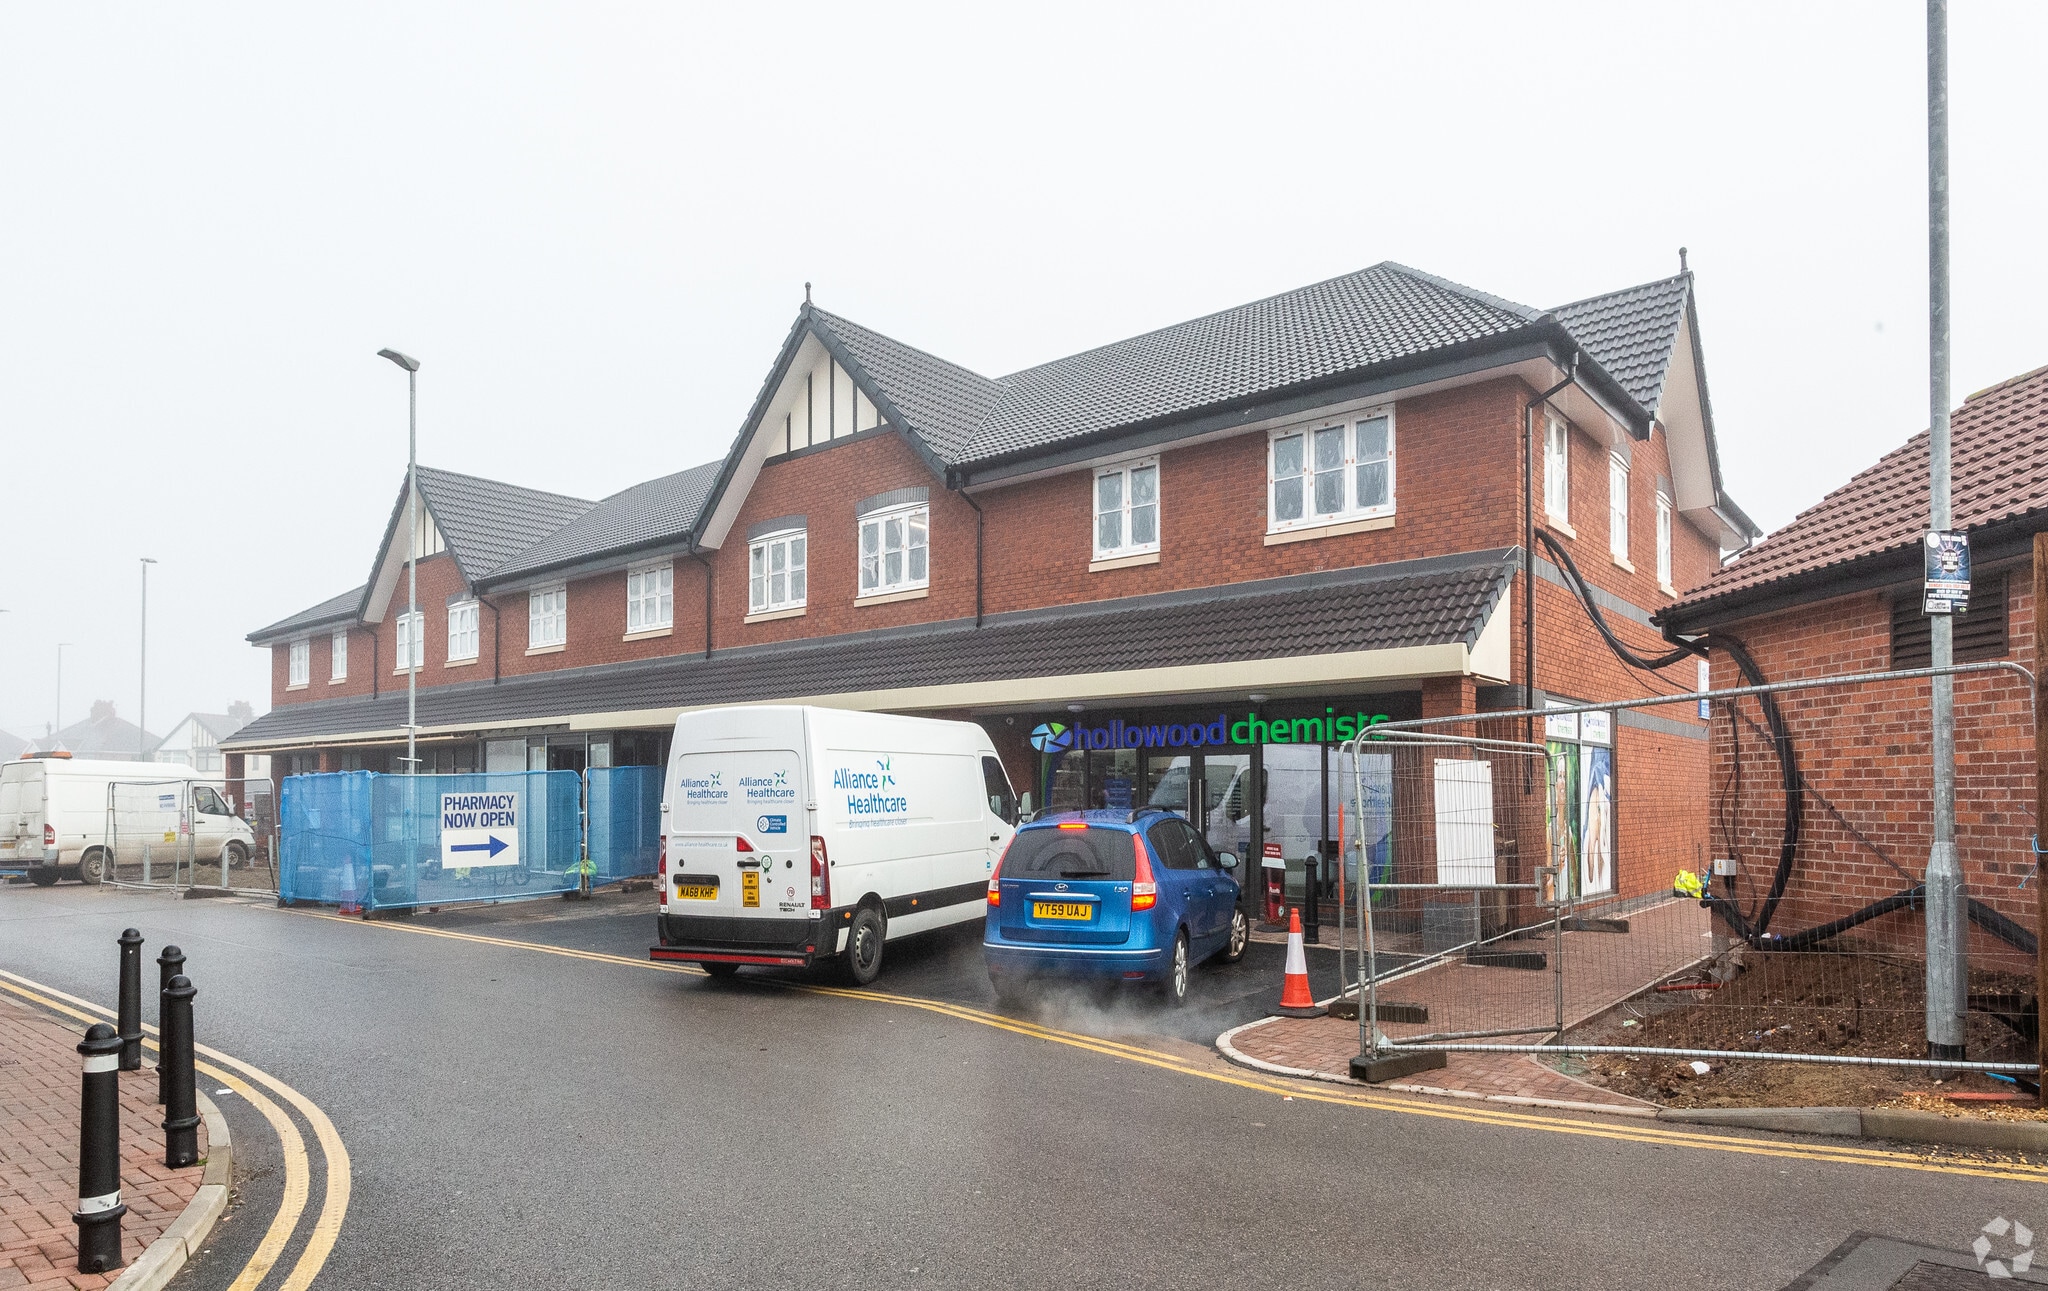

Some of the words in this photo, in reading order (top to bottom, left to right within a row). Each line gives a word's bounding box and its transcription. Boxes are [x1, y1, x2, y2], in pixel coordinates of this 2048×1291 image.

[1073, 714, 1226, 750] hollowood
[1231, 707, 1389, 745] chemists
[680, 779, 709, 788] Alliance
[739, 776, 773, 787] Alliance
[834, 767, 879, 789] Alliance
[687, 788, 728, 799] Healthcare
[747, 787, 795, 798] Healthcare
[444, 794, 515, 811] PHARMACY
[847, 793, 907, 815] Healthcare
[444, 812, 477, 829] NOW
[480, 811, 515, 828] OPEN
[680, 886, 699, 898] MA68
[700, 887, 715, 898] KHF
[1038, 904, 1065, 916] YT59
[1066, 904, 1088, 917] UAJ
